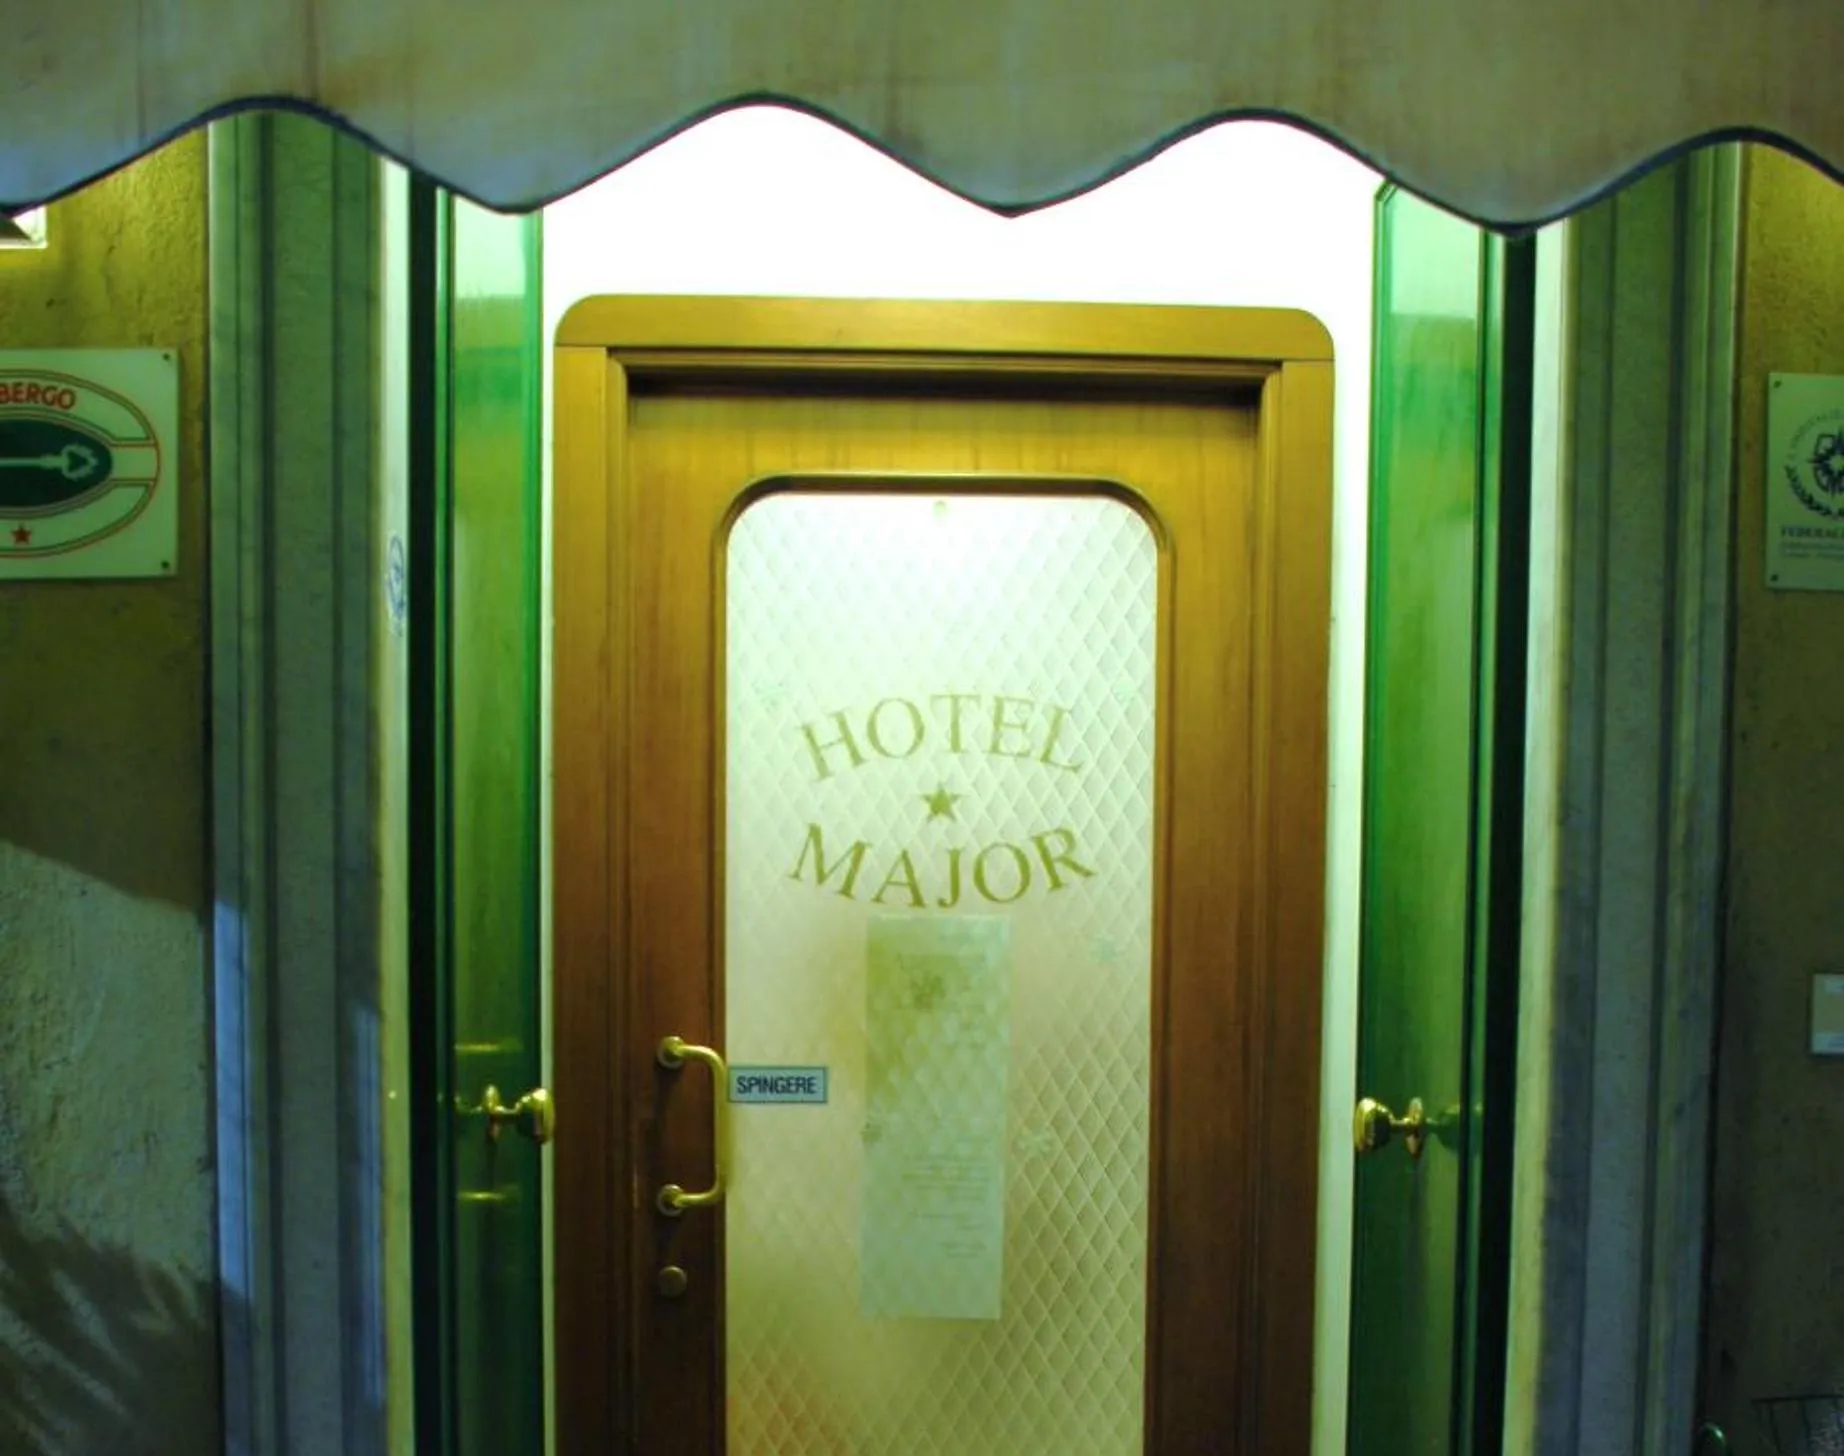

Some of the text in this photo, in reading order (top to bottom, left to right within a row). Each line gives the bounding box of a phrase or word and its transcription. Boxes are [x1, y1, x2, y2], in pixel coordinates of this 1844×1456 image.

[797, 694, 1083, 782] HOTEL
[788, 822, 1097, 908] MAJOR
[735, 1075, 818, 1095] SPINGERE
